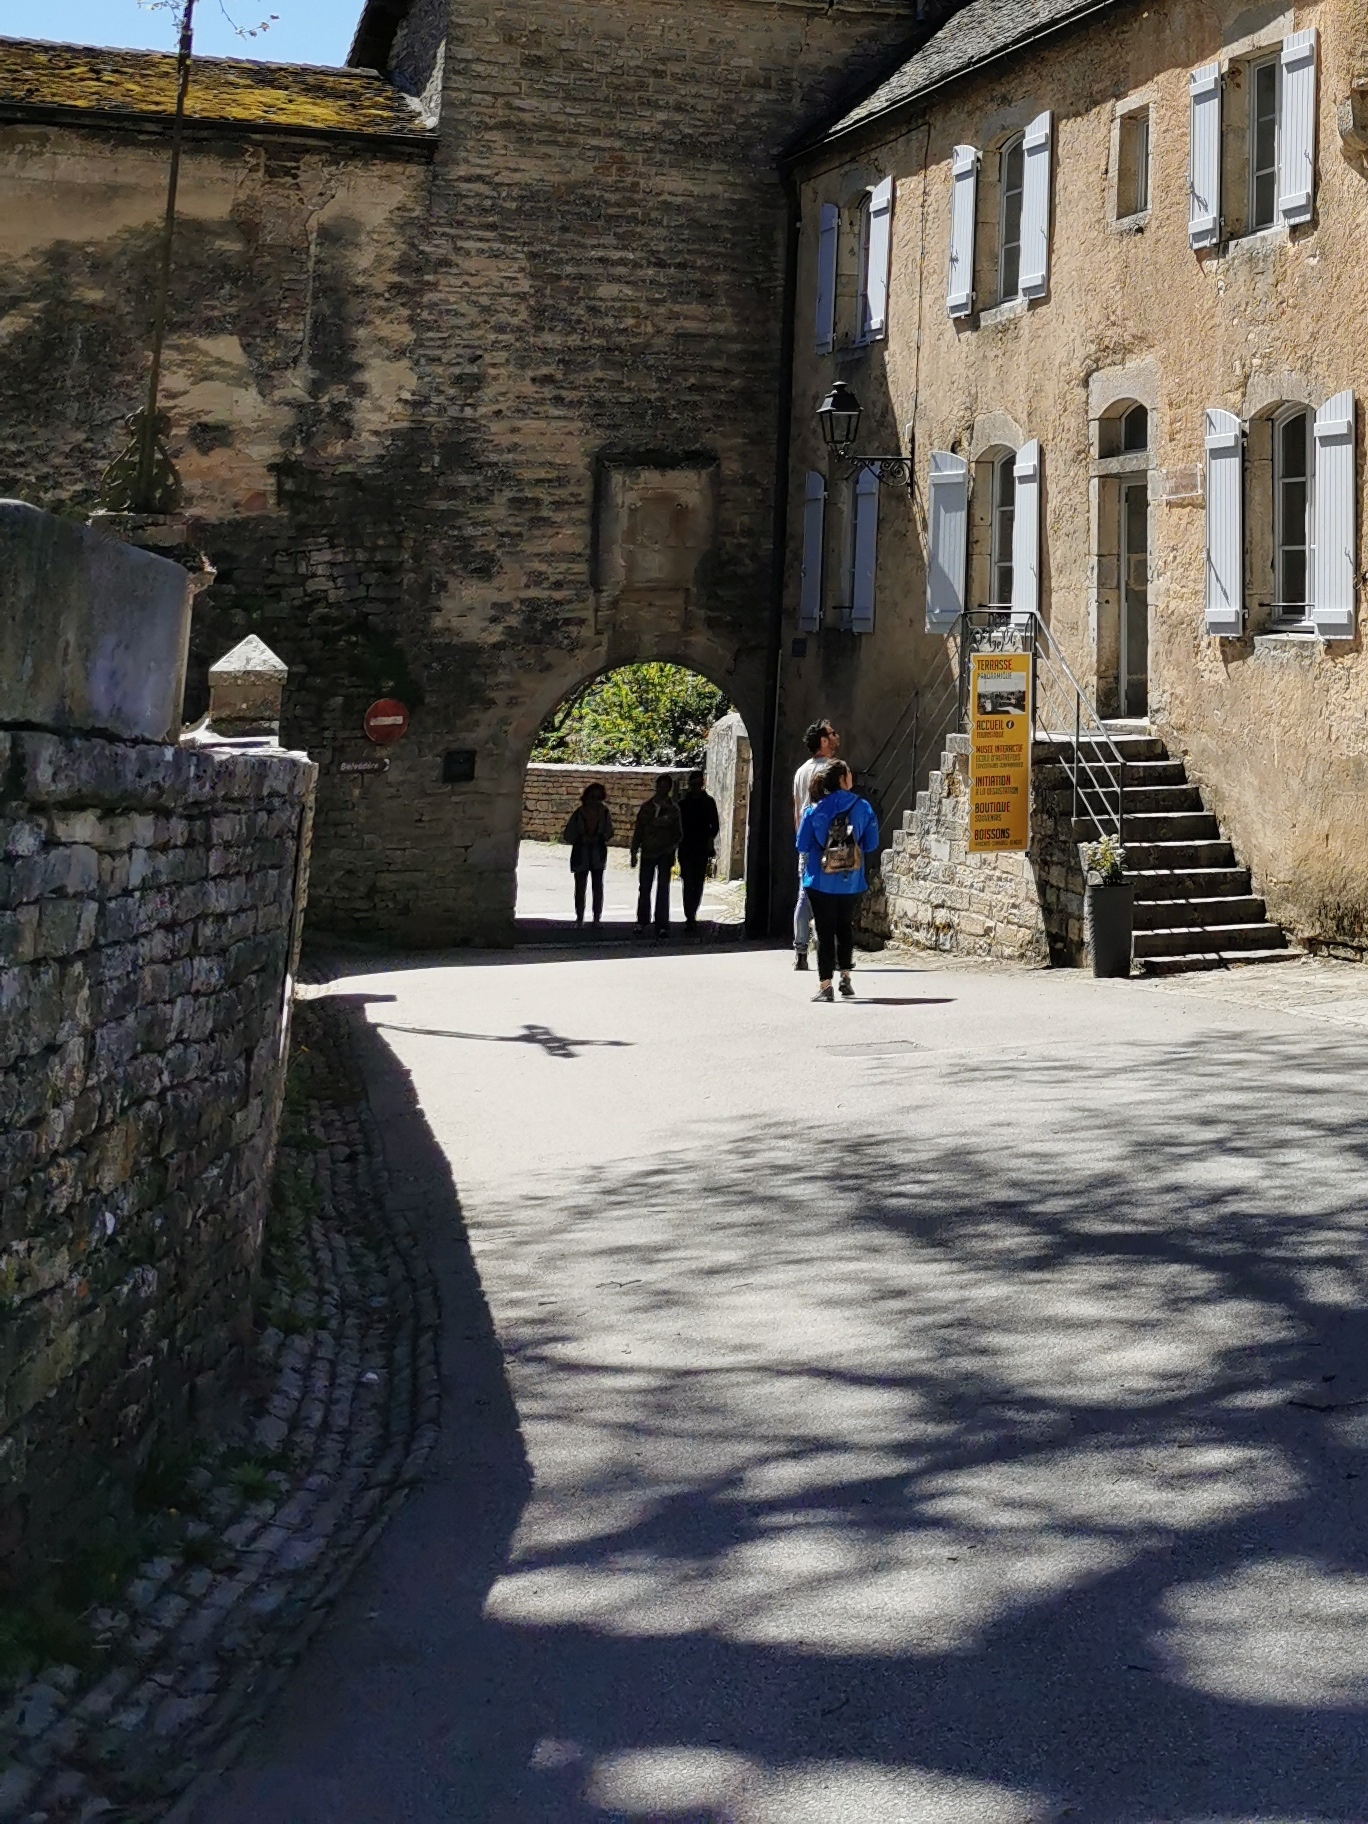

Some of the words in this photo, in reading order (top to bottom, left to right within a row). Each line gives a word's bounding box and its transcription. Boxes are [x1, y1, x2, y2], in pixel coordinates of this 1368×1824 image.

[977, 659, 1013, 671] TERRASSE
[977, 672, 1013, 680] PANORAMIQUE
[976, 719, 1005, 731] ACCUEIL
[975, 775, 1011, 787] INITIATION
[974, 801, 1011, 814] BOUTIQUE
[974, 814, 1002, 823] SOUVENIRS
[974, 827, 1010, 841] BOISSONS
